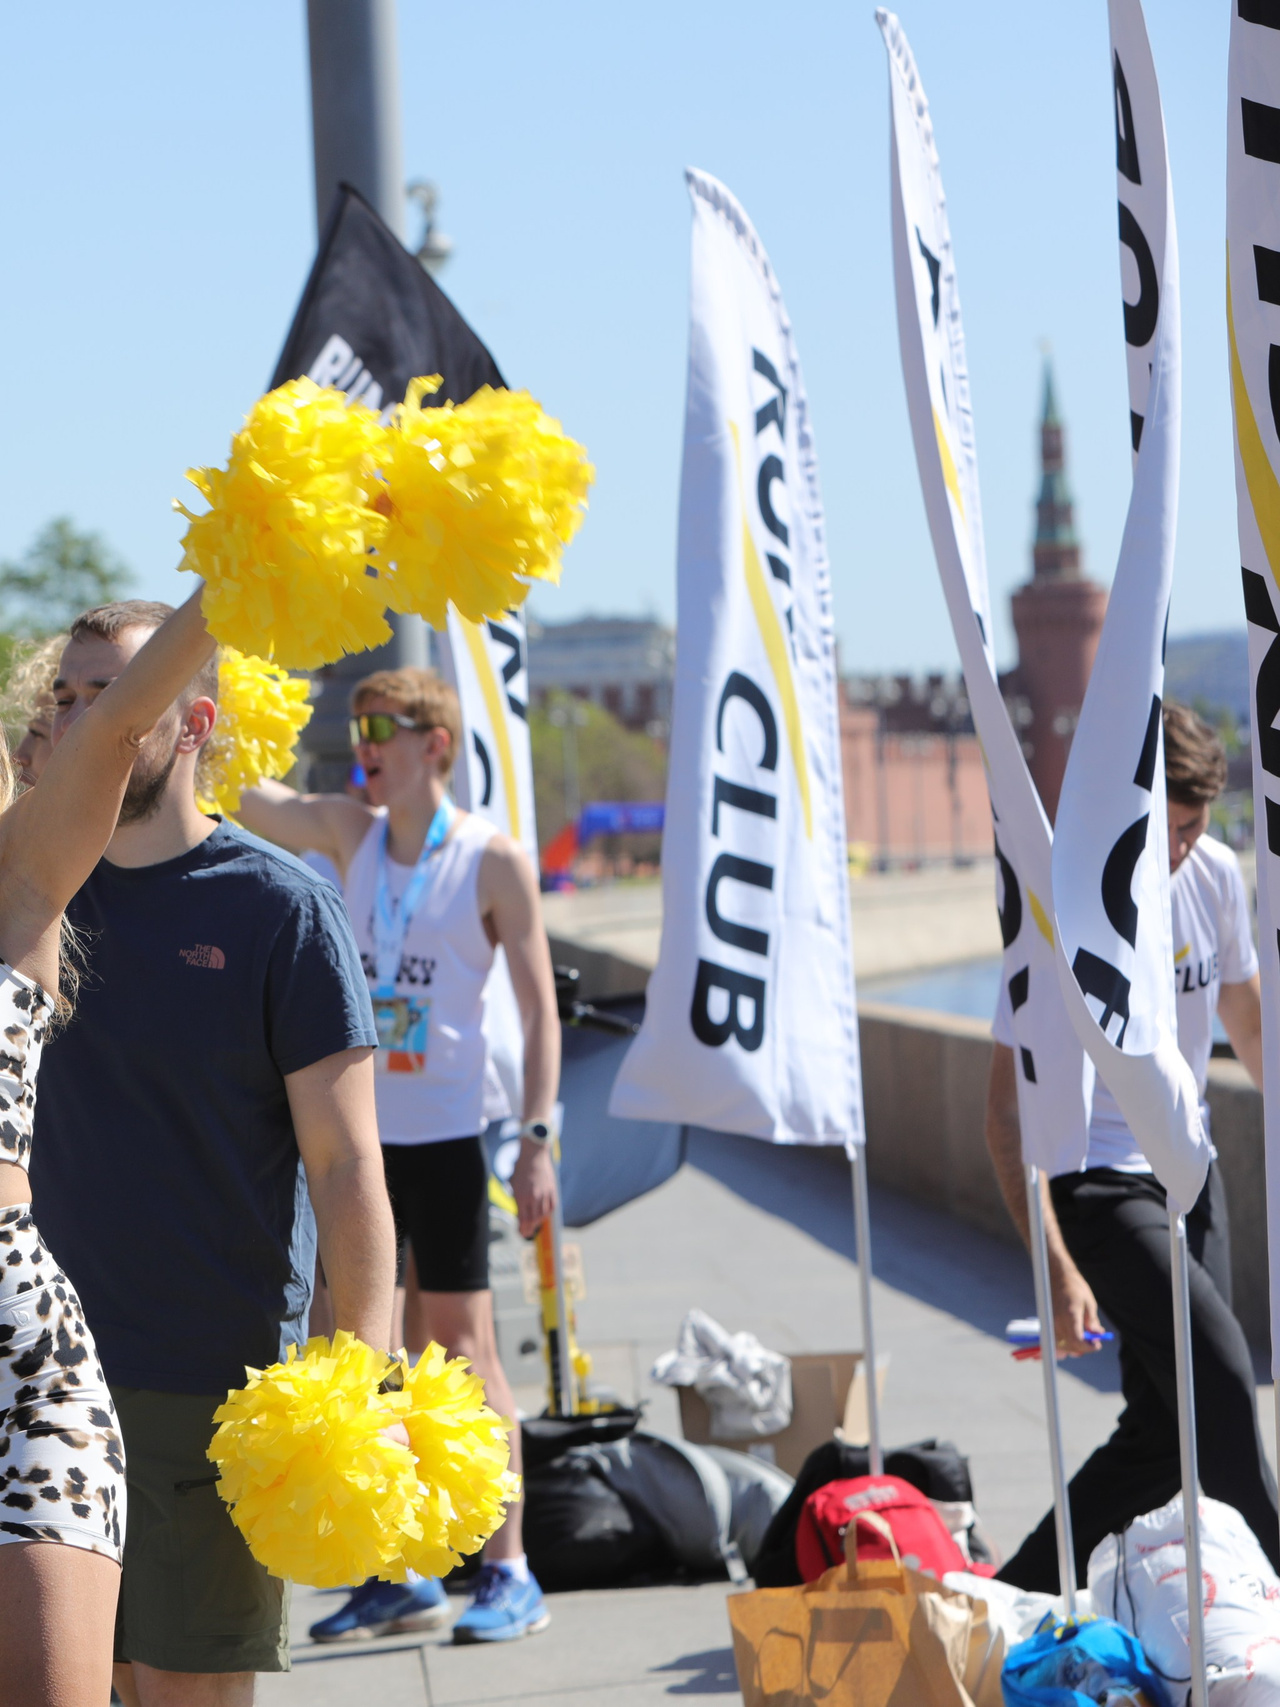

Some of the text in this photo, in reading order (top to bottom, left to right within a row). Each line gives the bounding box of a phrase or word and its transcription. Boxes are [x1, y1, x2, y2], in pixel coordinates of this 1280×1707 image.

[690, 671, 780, 1052] CLUB
[194, 943, 211, 952] THE
[179, 949, 210, 960] NORTH
[186, 957, 208, 968] FACE
